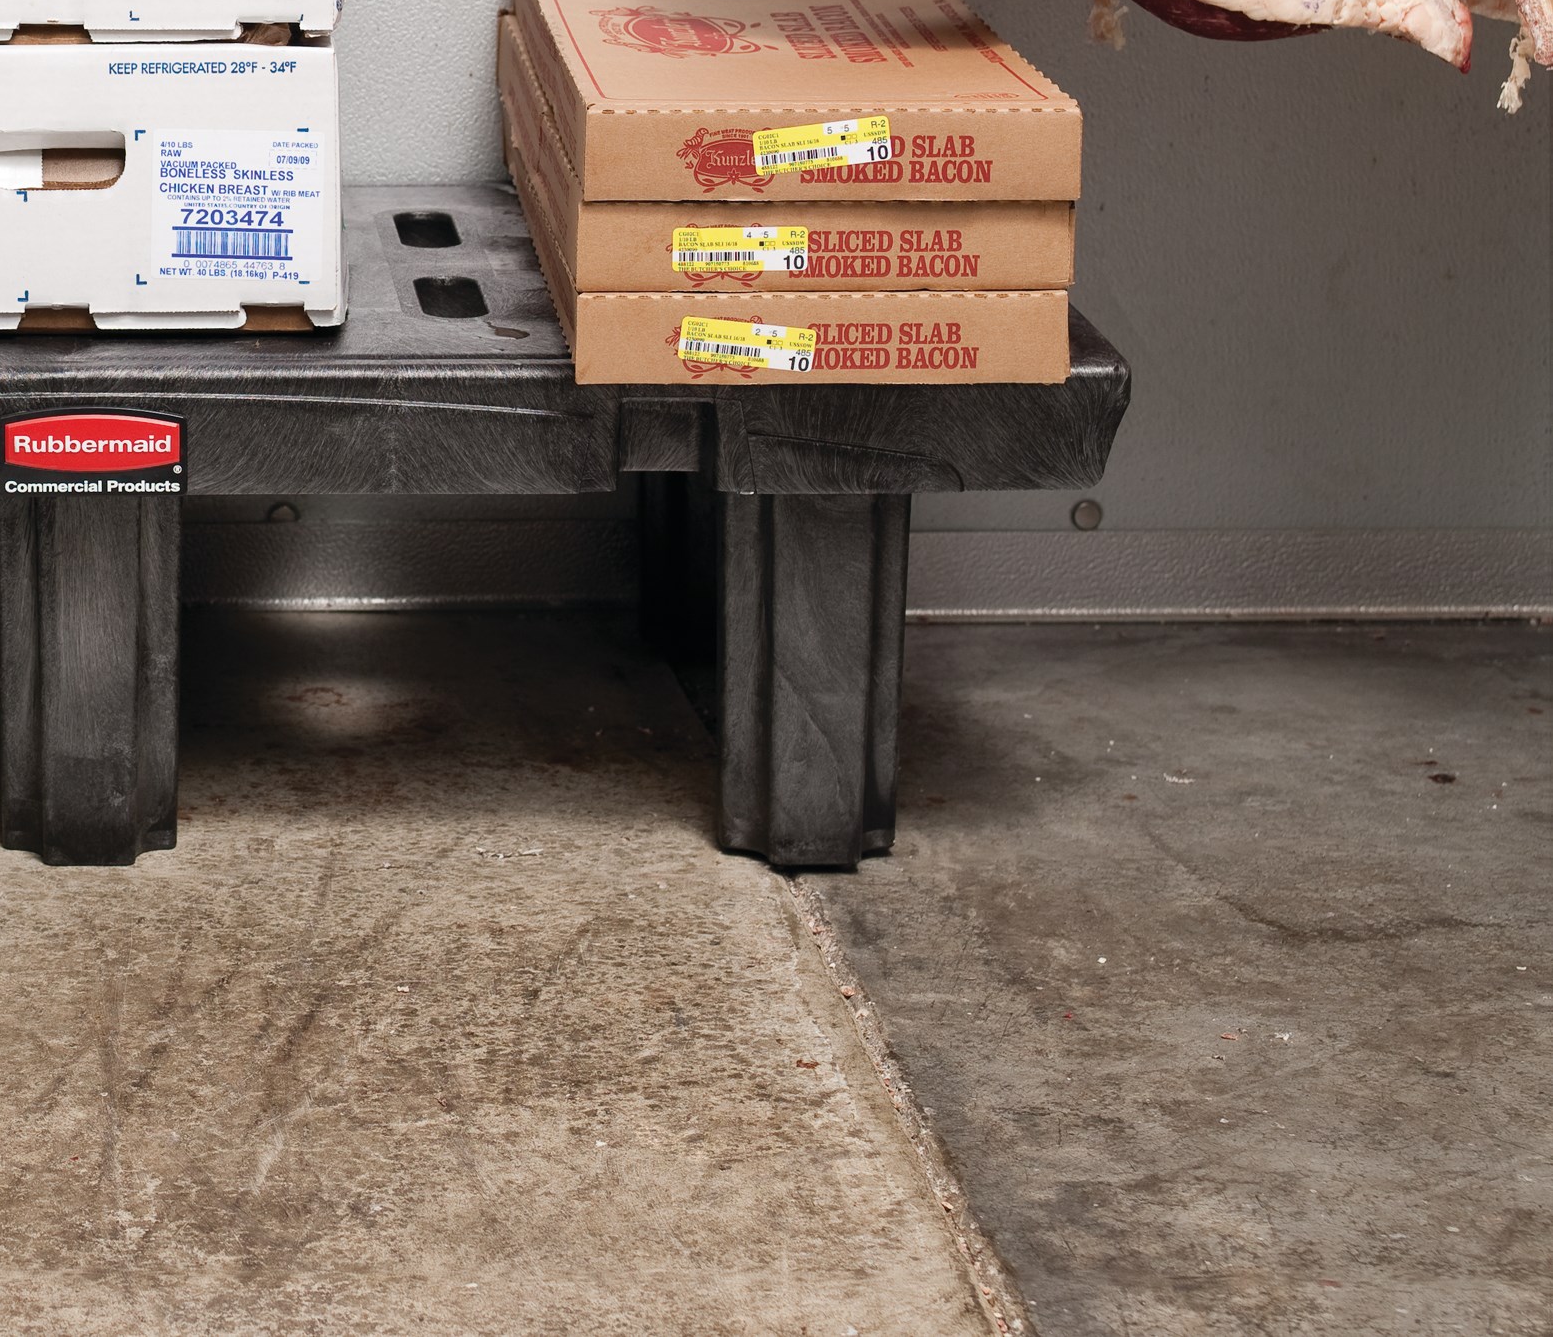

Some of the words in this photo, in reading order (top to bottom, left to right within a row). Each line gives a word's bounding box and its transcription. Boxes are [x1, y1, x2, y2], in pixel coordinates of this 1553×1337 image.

[108, 63, 138, 75] KEEP
[141, 62, 227, 74] REFRIGERATED
[870, 120, 886, 128] R-2
[872, 136, 888, 145] 485
[911, 135, 975, 158] SLAB
[160, 149, 182, 157] RAW
[276, 155, 310, 165] 07/09/09
[705, 150, 756, 169] Kunzle
[867, 145, 888, 161] 10
[160, 160, 198, 169] VACUUM
[200, 161, 237, 170] PACKED
[908, 160, 993, 183] BACON
[159, 168, 227, 179] BONELESS
[233, 169, 294, 181] SKINLESS
[159, 182, 215, 194] CHICKEN
[218, 184, 268, 196] BREAST
[298, 190, 321, 198] MEAT
[180, 208, 284, 227] 7203474
[807, 230, 893, 253] SLICED
[899, 230, 963, 253] SLAB
[195, 260, 238, 269] 0074865
[243, 261, 274, 270] 44763
[783, 255, 805, 270] 10
[896, 254, 980, 278] BACON
[159, 268, 177, 276] NET
[179, 268, 194, 276] WT.
[230, 269, 268, 279] (18.16kg)
[272, 271, 299, 280] P-419
[798, 332, 814, 341] R-2
[807, 323, 893, 345] SLICED
[898, 323, 962, 345] SLAB
[795, 348, 812, 357] 485
[812, 348, 891, 370] MOKED
[895, 347, 979, 370] BACON
[788, 356, 810, 372] 10
[13, 435, 171, 454] Rubbermaid
[4, 480, 103, 493] Commercial
[107, 480, 181, 493] Products
